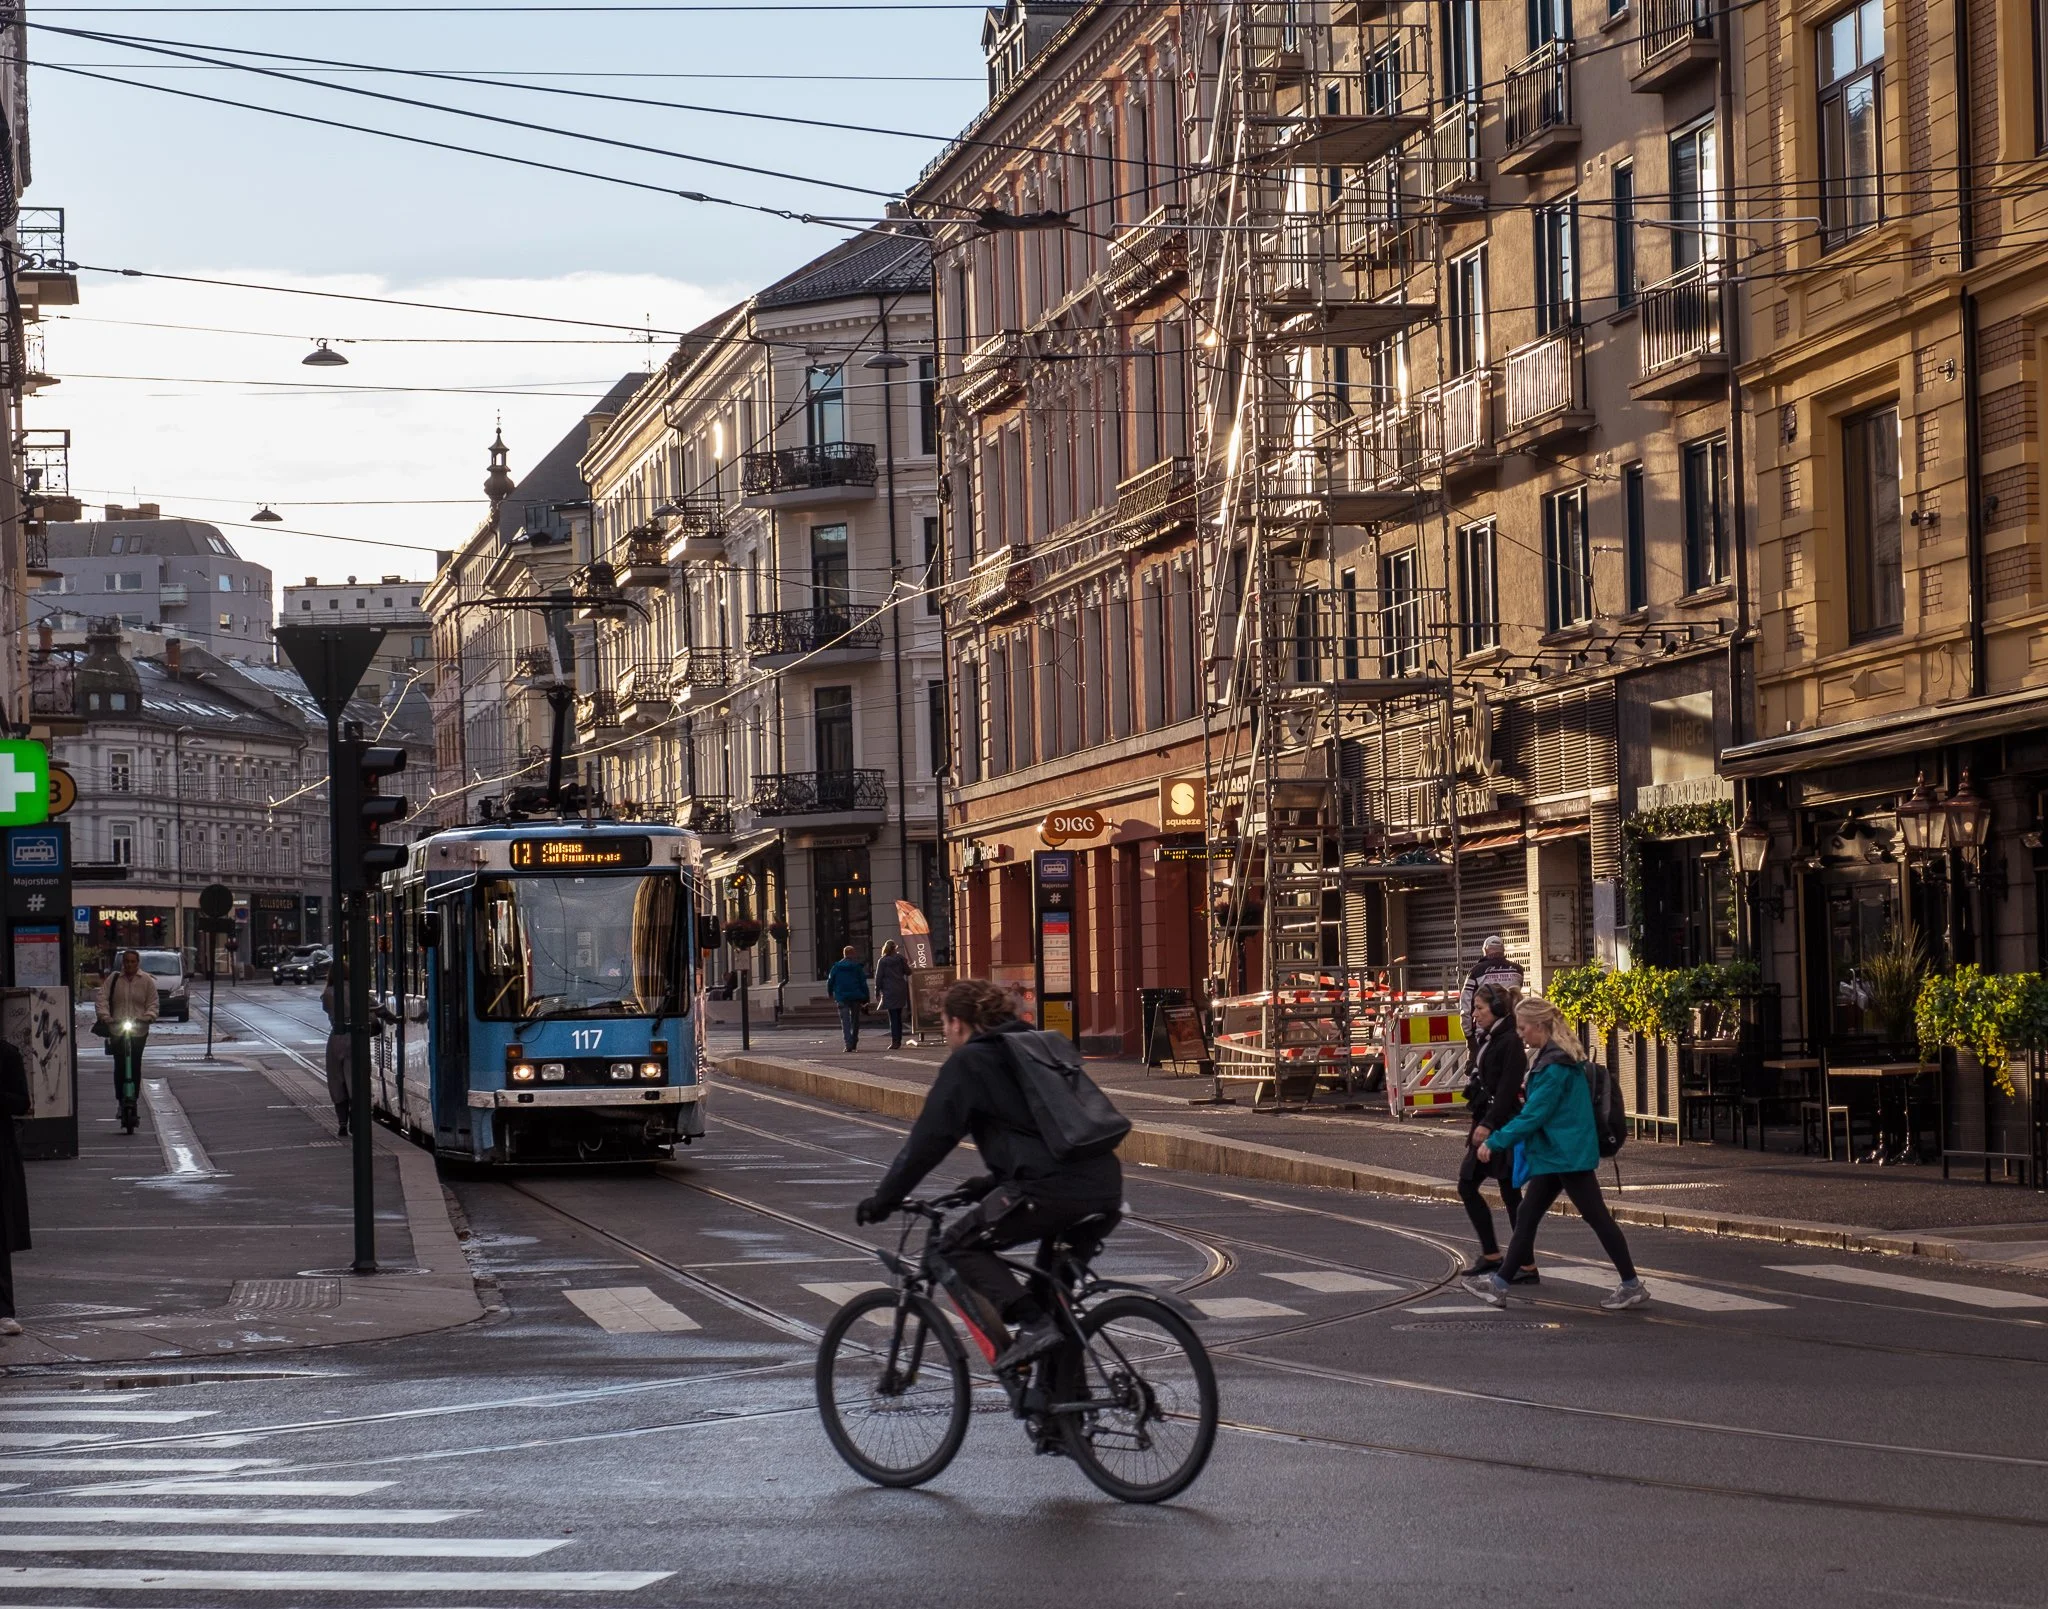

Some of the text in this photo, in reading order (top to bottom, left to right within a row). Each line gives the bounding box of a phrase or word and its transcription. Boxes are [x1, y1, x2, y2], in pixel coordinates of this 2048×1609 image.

[1645, 780, 1725, 807] RESTAURANT
[1475, 789, 1491, 814] BAR
[1054, 816, 1095, 832] DIGG
[1166, 818, 1201, 827] squeeze
[13, 878, 59, 887] Majorstuen
[77, 908, 86, 920] P
[116, 910, 138, 921] BOK
[571, 1030, 603, 1050] 117
